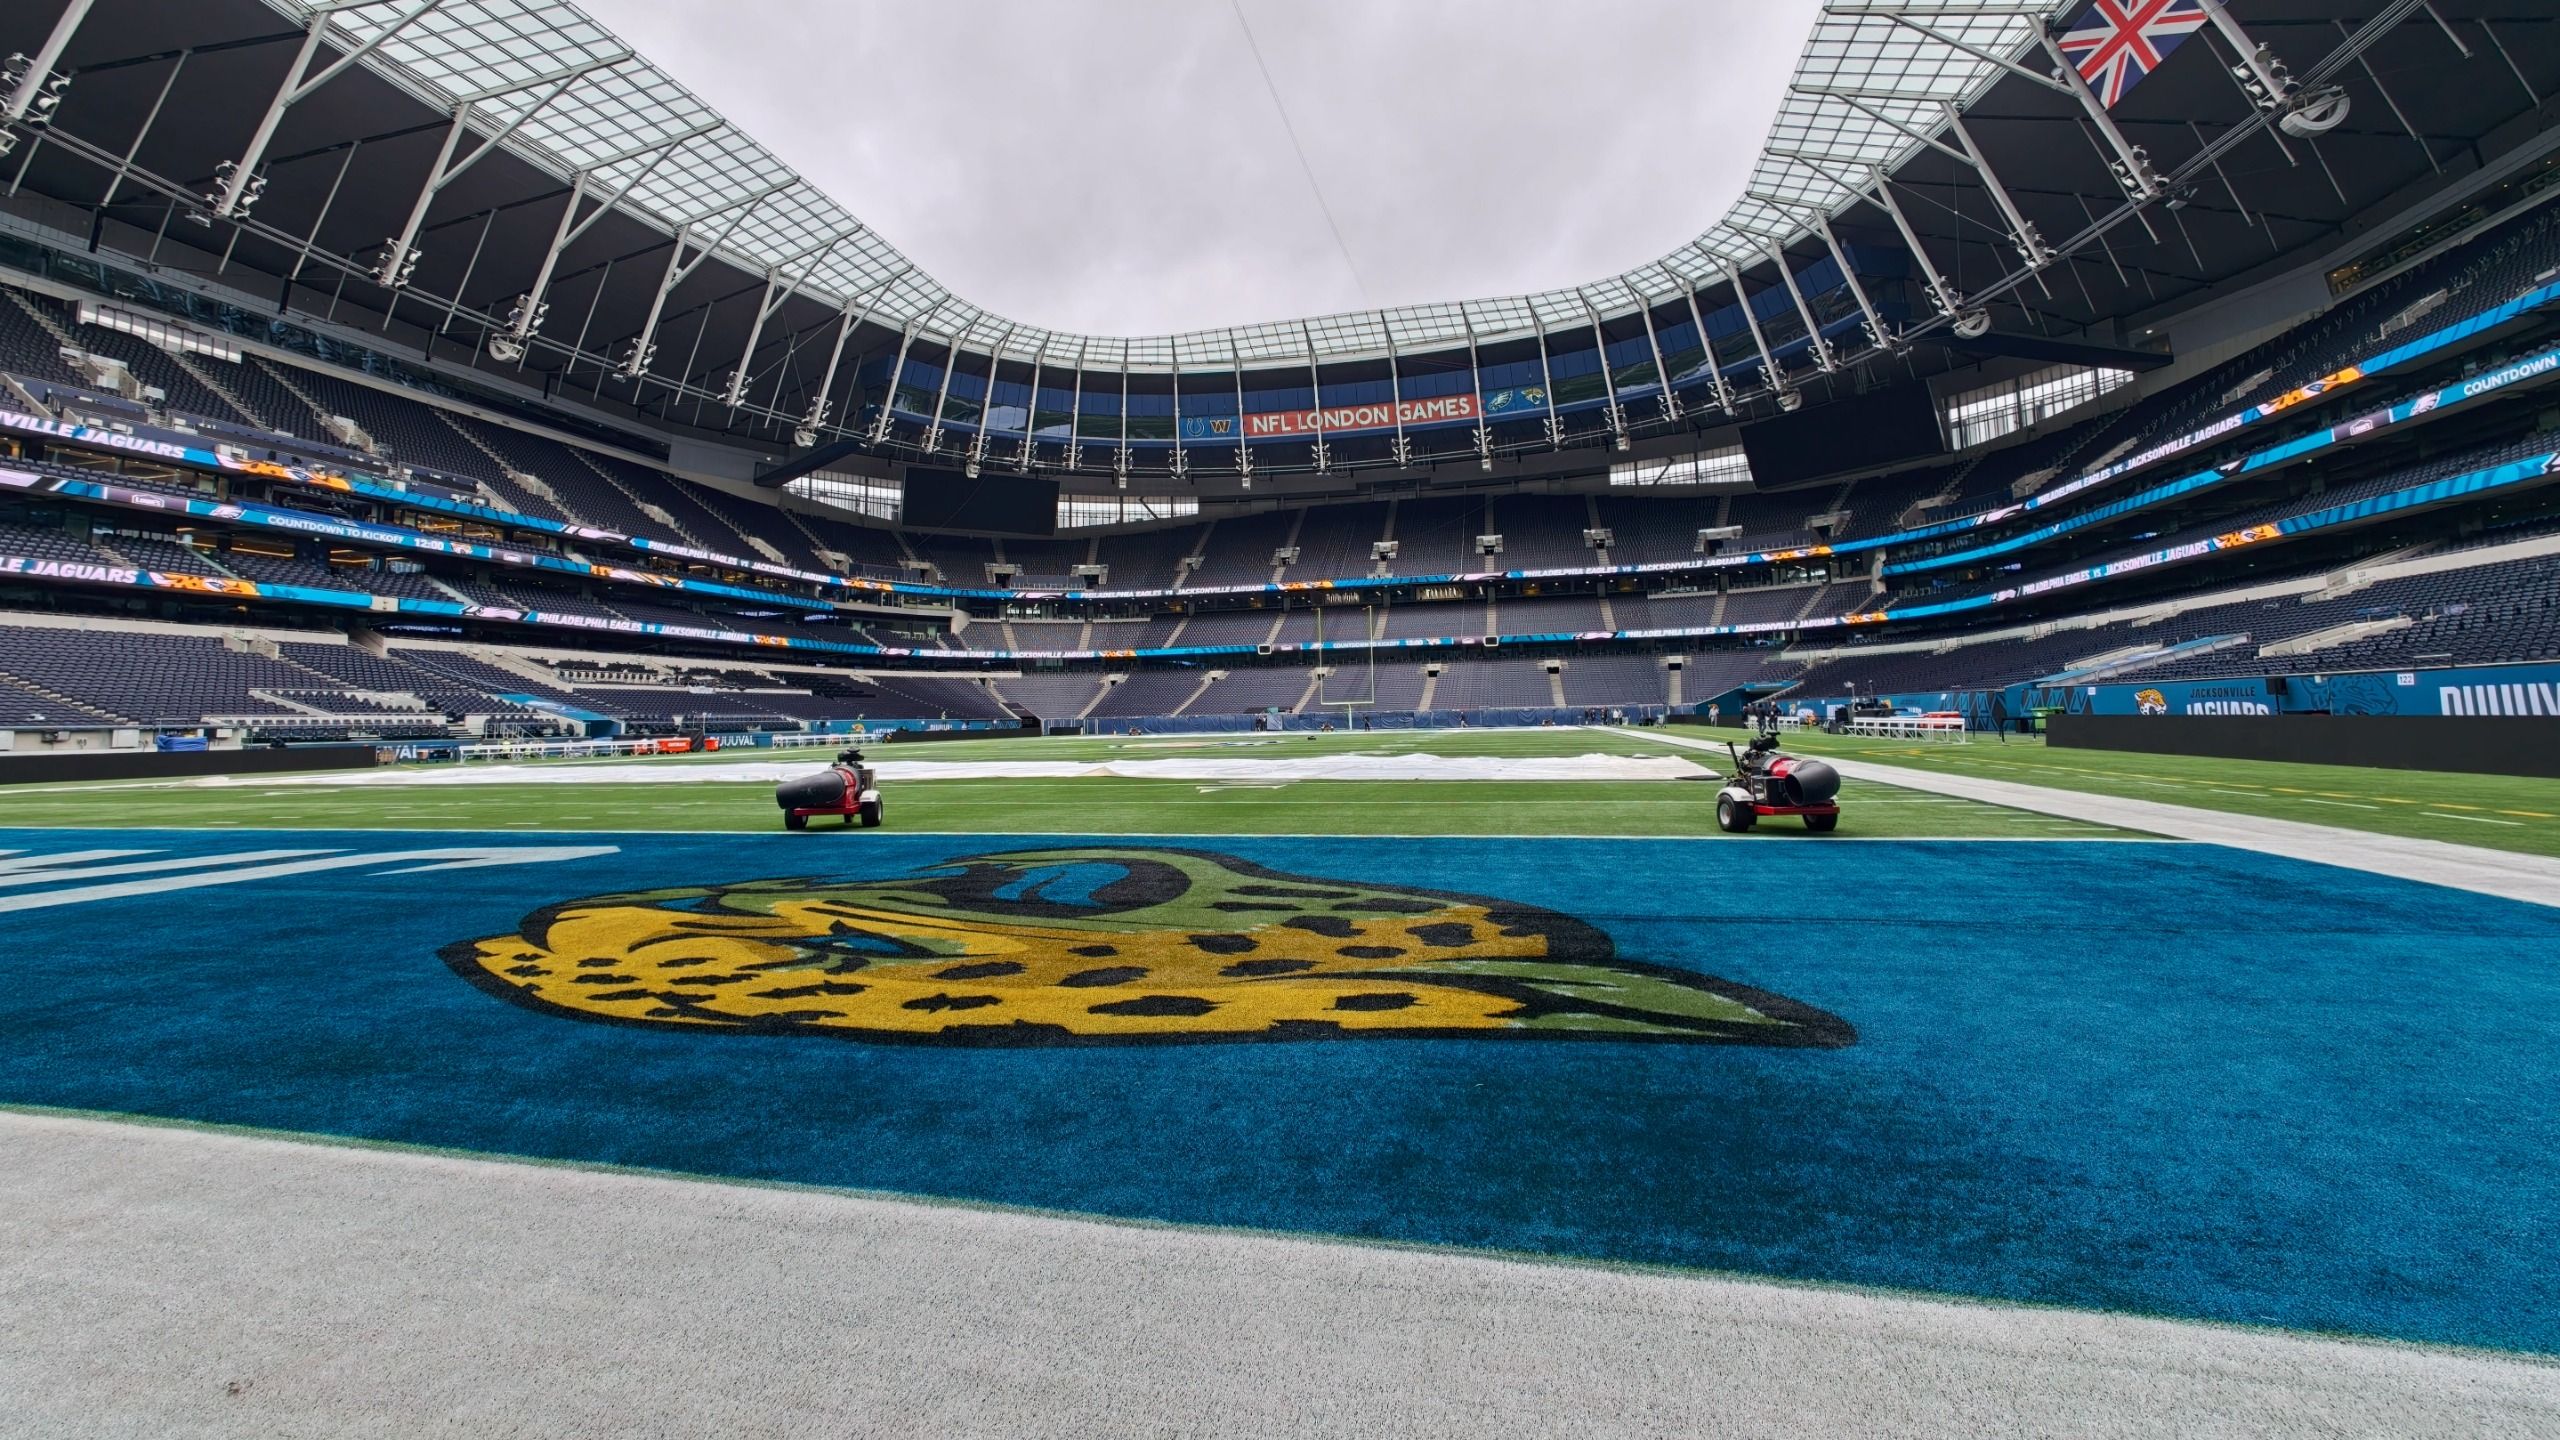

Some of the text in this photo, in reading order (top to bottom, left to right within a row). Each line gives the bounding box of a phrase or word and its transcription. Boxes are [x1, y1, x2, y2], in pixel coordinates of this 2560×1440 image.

[2464, 355, 2557, 396] COUNTDOWN
[1253, 397, 1470, 433] NFL LONDON GAMES
[0, 411, 186, 458] VILLE JAGUARS
[2037, 480, 2082, 506] PHILADELPHIA
[2084, 467, 2111, 487] EAGLES
[2126, 437, 2191, 470] JACKSONVILLE
[2191, 414, 2242, 444] JAGUARS
[268, 515, 444, 550] COUNTDOWN TO KICKOFF 12:00
[28, 560, 138, 584] JAGUARS
[648, 541, 708, 560] PHILADELPHIA
[710, 552, 738, 565] EAGLES
[751, 561, 801, 577] JACKSONVILLE
[801, 571, 831, 583] JAGUARS
[1523, 567, 1583, 577] PHILADELPHIA
[1586, 566, 1617, 574] EAGLES
[1636, 559, 1702, 572] JACKSONVILLE
[1704, 556, 1748, 567] JAGUARS
[2023, 575, 2064, 595] PHILADELPHIA
[2065, 569, 2090, 585] EAGLES
[2104, 552, 2163, 576] JACKSONVILLE
[2164, 540, 2209, 561] JAGUARS
[1080, 591, 1134, 599] PHILADELPHIA
[1135, 589, 1161, 597] EAGLES
[1176, 586, 1230, 595] JACKSONVILLE
[1230, 584, 1265, 592] JAGUARS
[537, 614, 608, 629] PHILADELPHIA
[610, 620, 642, 632] EAGLES
[659, 625, 716, 639] JACKSONVILLE
[717, 631, 749, 642] JAGUARS
[1625, 629, 1682, 638] PHILADELPHIA
[1685, 627, 1716, 636] EAGLES
[1733, 620, 1796, 633] JACKSONVILLE
[1798, 618, 1836, 629] JAGUARS
[920, 650, 968, 658] PHILADELPHIA
[969, 650, 995, 658] EAGLES
[1009, 650, 1061, 658] JACKSONVILLE
[1062, 650, 1095, 658] JAGUARS
[2190, 686, 2255, 698] JACKSONVILLE
